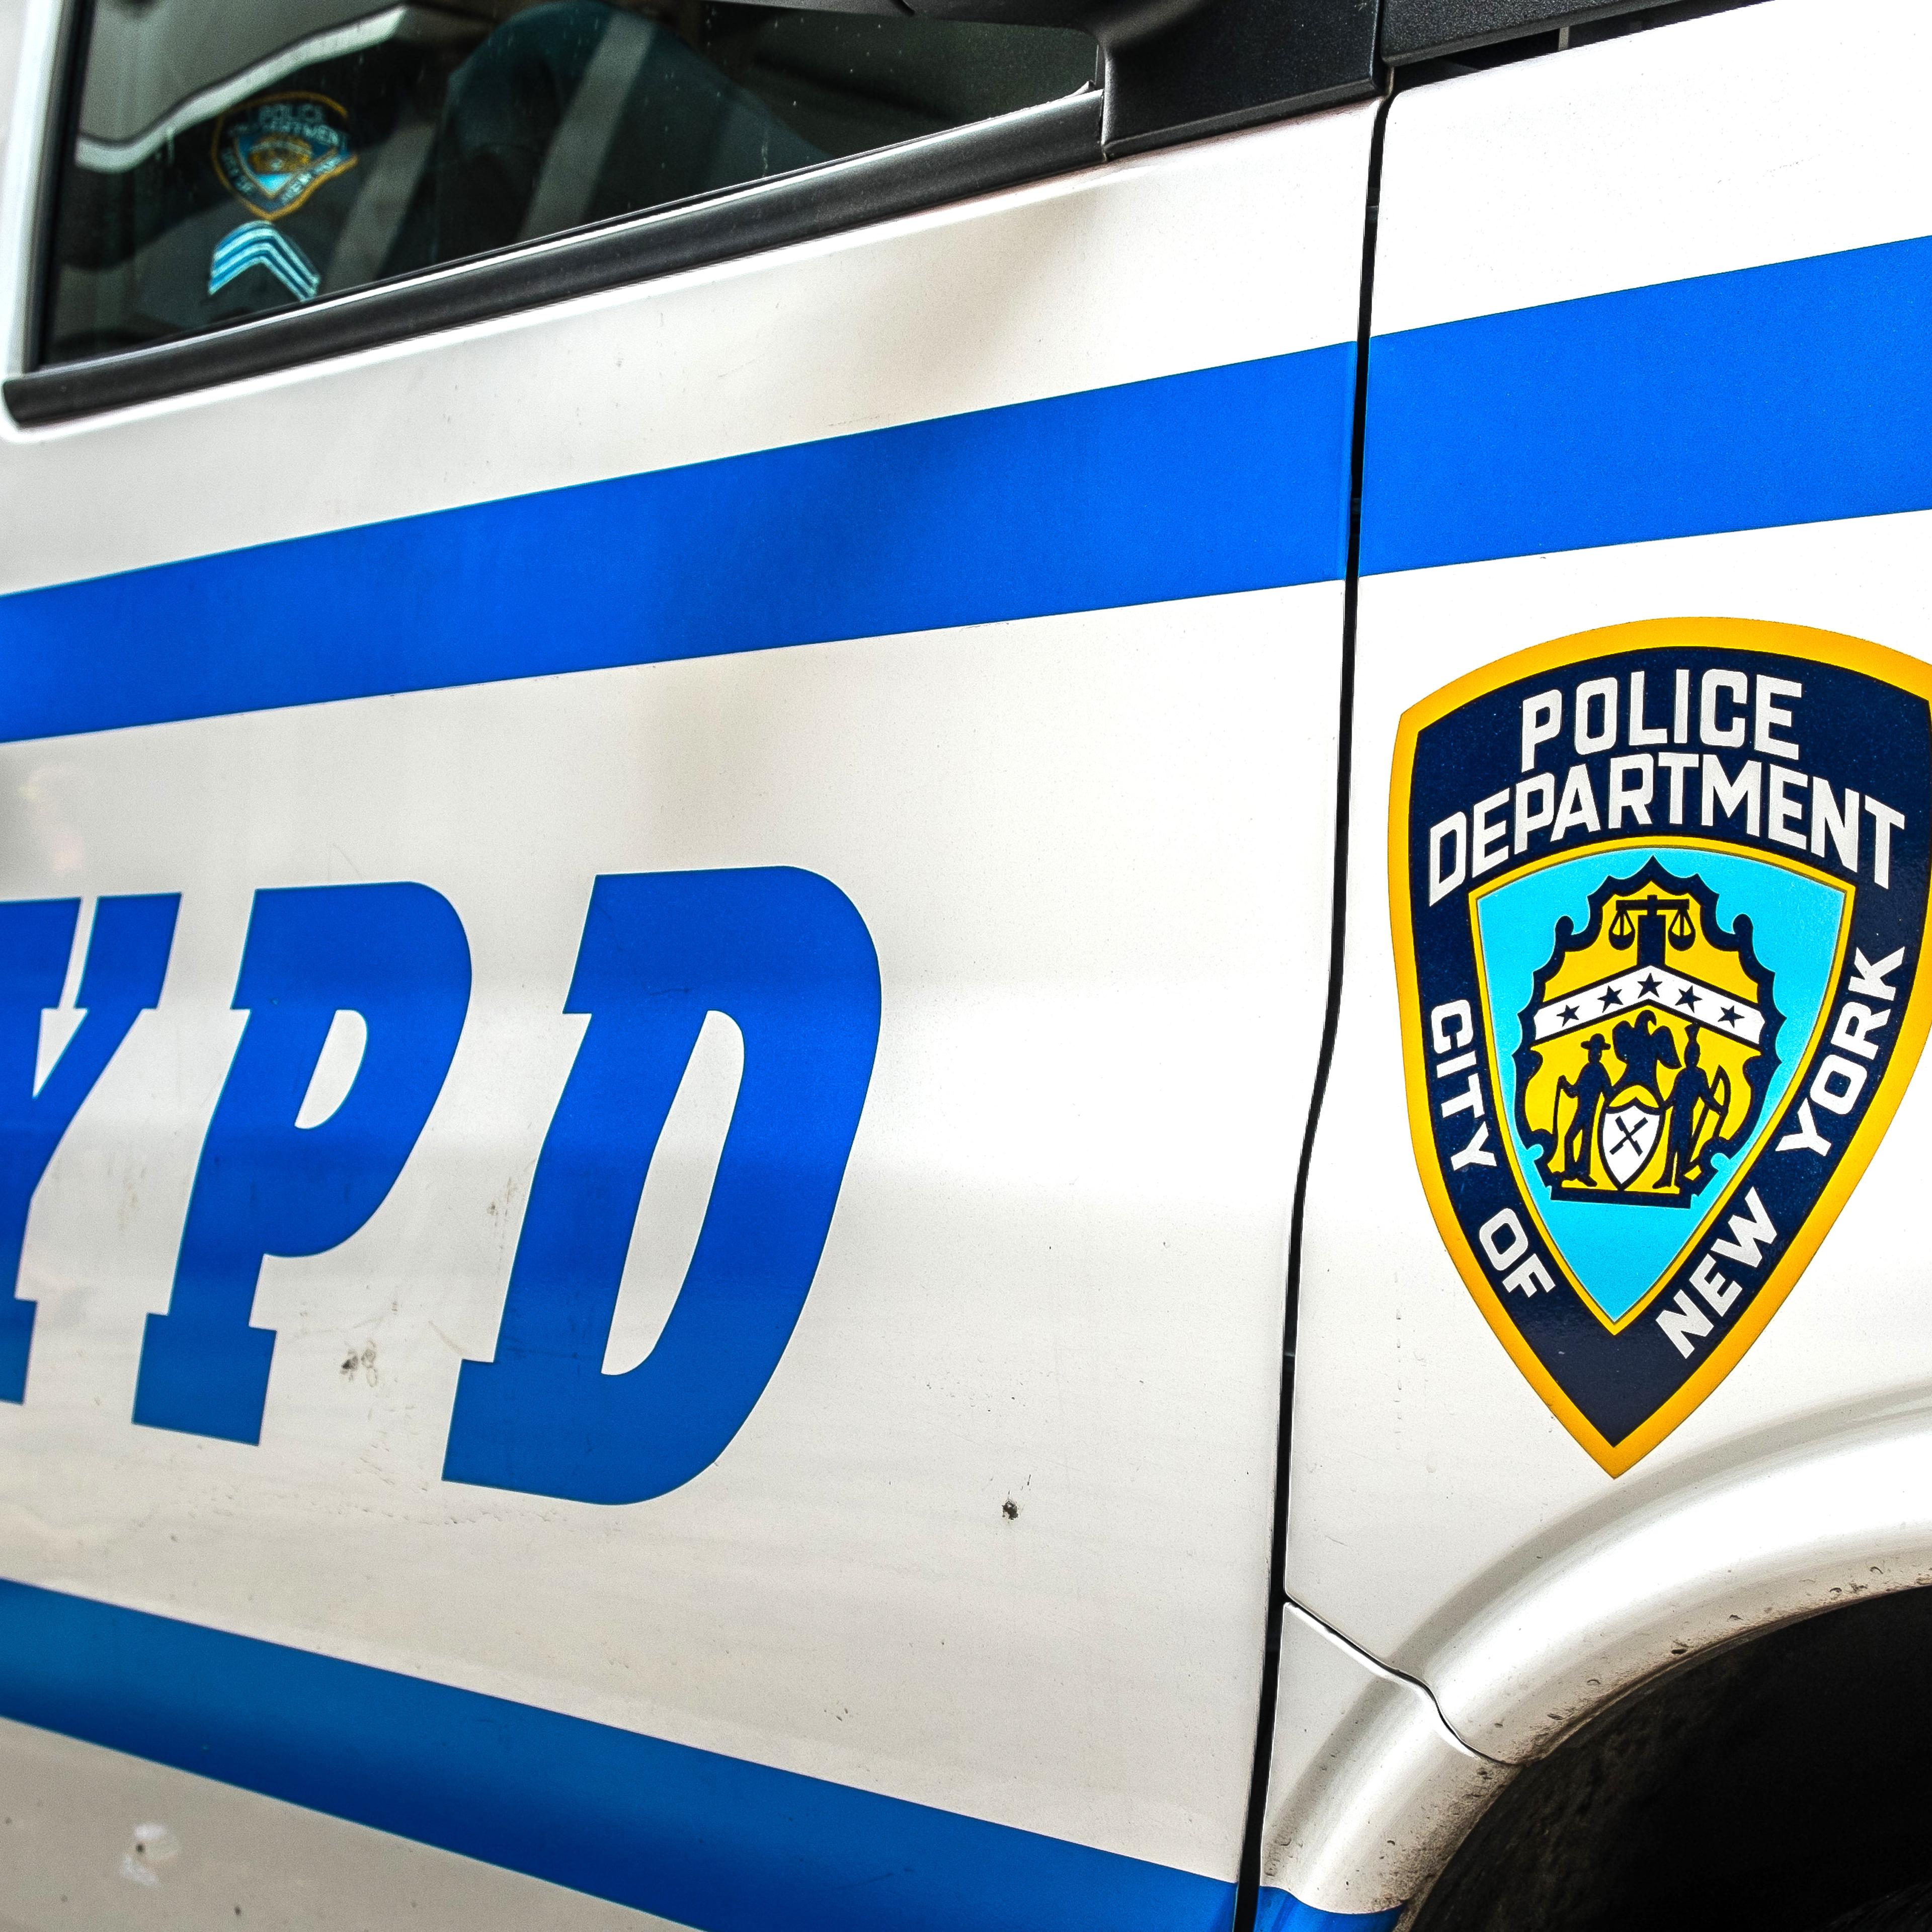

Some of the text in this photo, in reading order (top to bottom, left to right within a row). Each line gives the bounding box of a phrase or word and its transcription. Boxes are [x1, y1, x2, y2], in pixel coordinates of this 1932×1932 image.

[1430, 752, 1905, 906] DEPARTMENT
[1521, 668, 1802, 772] POLICE
[0, 865, 882, 1505] YPD
[1431, 999, 1555, 1297] CITY OF
[1656, 947, 1905, 1358] NEW YORK
